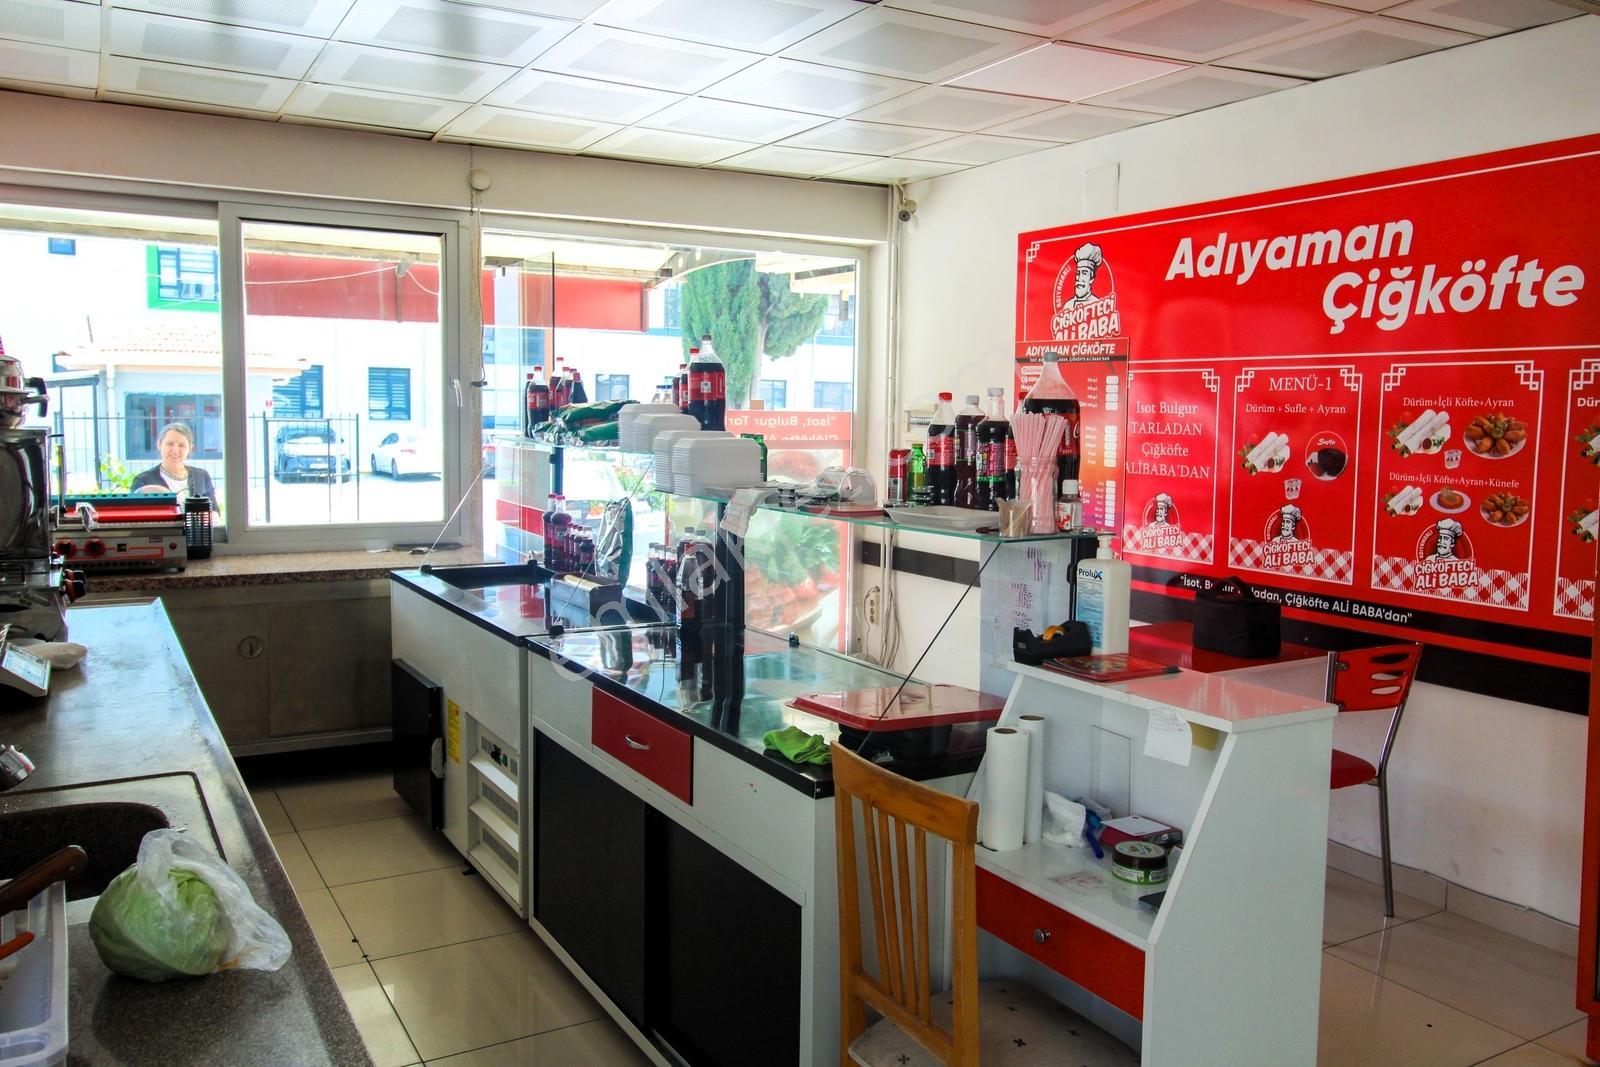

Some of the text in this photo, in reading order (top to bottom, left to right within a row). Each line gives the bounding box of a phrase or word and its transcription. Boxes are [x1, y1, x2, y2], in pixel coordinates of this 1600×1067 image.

[1165, 218, 1414, 286] Adıyaman
[1321, 254, 1586, 335] Çiğköfte
[1077, 312, 1119, 341] BABA
[1071, 341, 1115, 356] ÇİĞKÖFTE
[1269, 374, 1332, 391] MENÜ-1
[1136, 399, 1198, 417] İsot Bulgur
[1246, 403, 1275, 413] Dürüm
[1284, 403, 1307, 413] Sufle
[1317, 404, 1346, 416] Ayran
[1403, 396, 1514, 410] Dürüm+İçli Köfte+Ayran
[1130, 421, 1202, 435] TARLADAN
[1141, 441, 1189, 458] Çiğköfte
[1433, 475, 1520, 488] Köfte+Ayran+Künefe
[1157, 534, 1183, 548] BABA
[1283, 551, 1314, 565] BABA
[1439, 571, 1478, 587] BABA
[1285, 593, 1330, 610] Çiğköfte
[1331, 600, 1350, 613] ALİ
[1352, 604, 1413, 623] BABA'dan"
